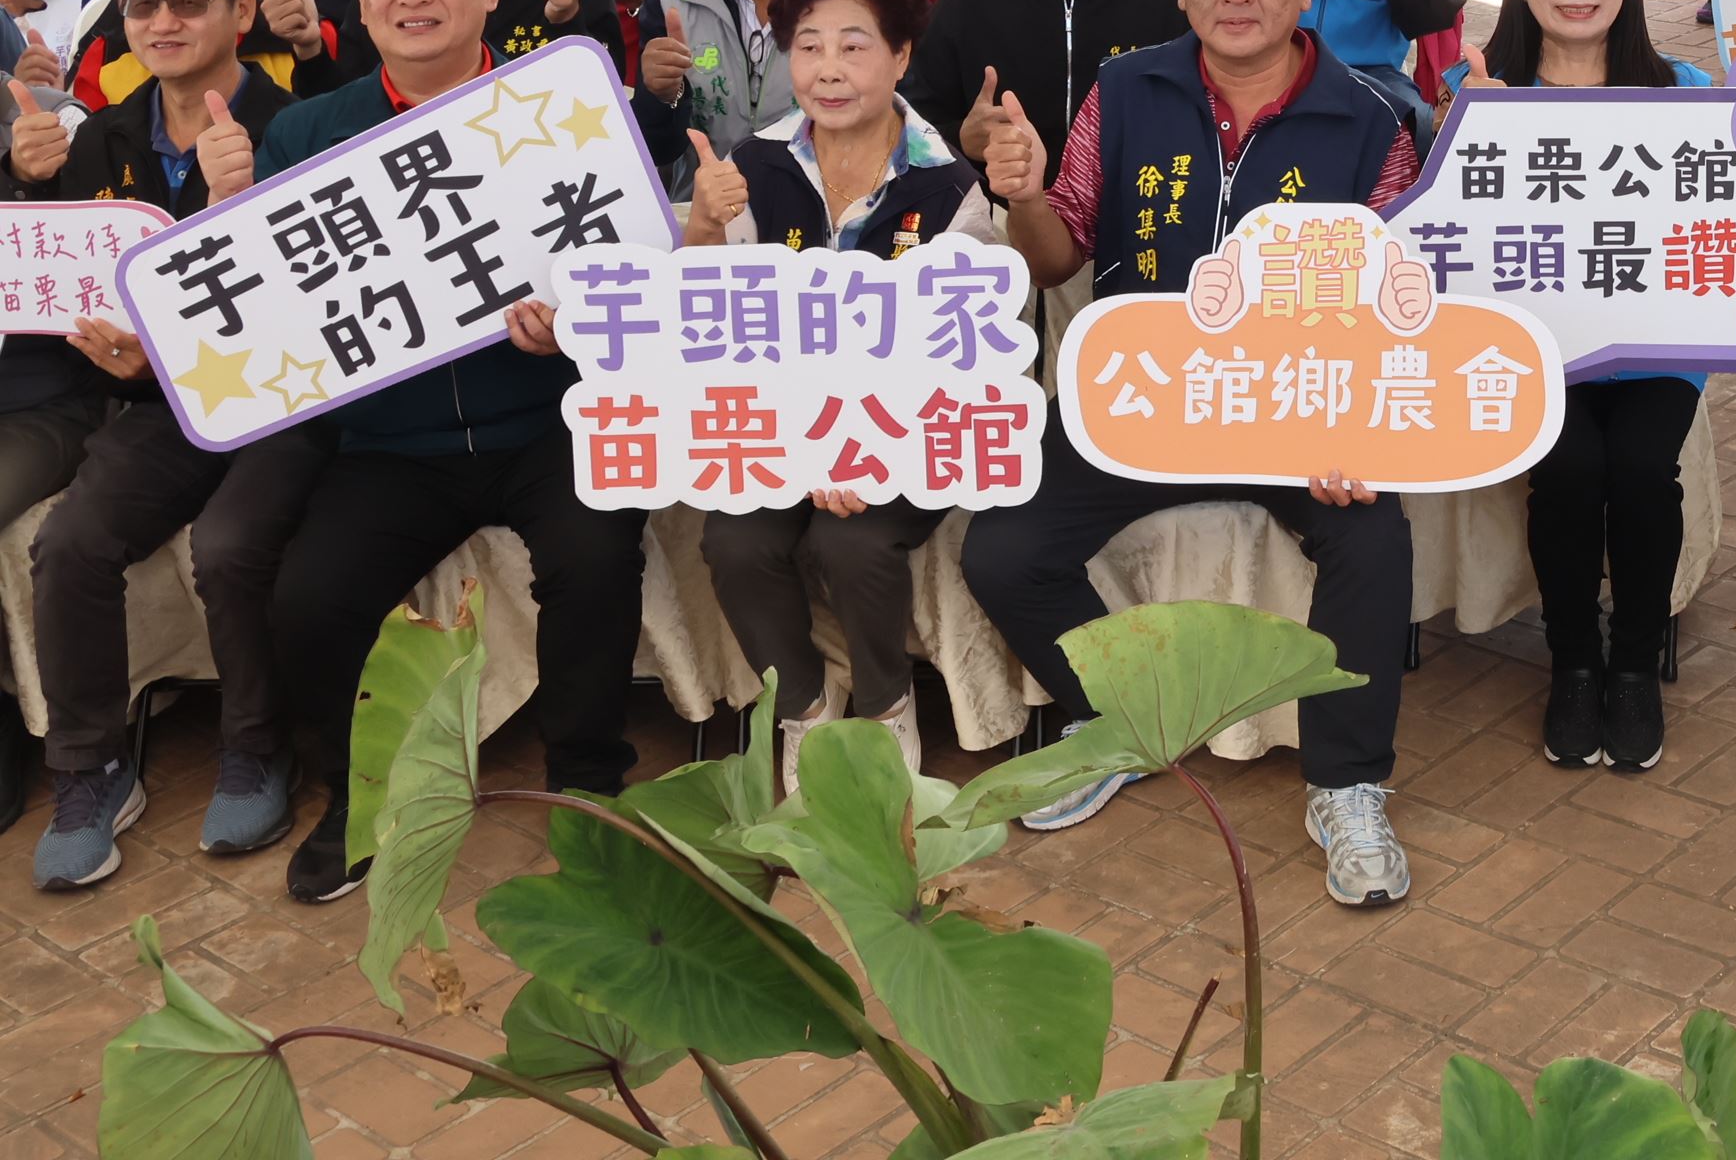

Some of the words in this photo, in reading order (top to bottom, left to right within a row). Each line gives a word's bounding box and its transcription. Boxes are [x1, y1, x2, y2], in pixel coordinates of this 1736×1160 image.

[711, 74, 731, 117] 代表
[155, 129, 484, 338] 芋頭界
[1135, 165, 1166, 282] 徐集明
[1163, 153, 1193, 225] 理事長
[0, 273, 115, 317] 苗栗最
[320, 171, 625, 378] 的王者
[569, 252, 1019, 371] 芋頭的家
[1258, 215, 1368, 330] 讚
[579, 384, 1029, 495] 苗栗公館
[1093, 343, 1534, 433] 公館鄉農會
